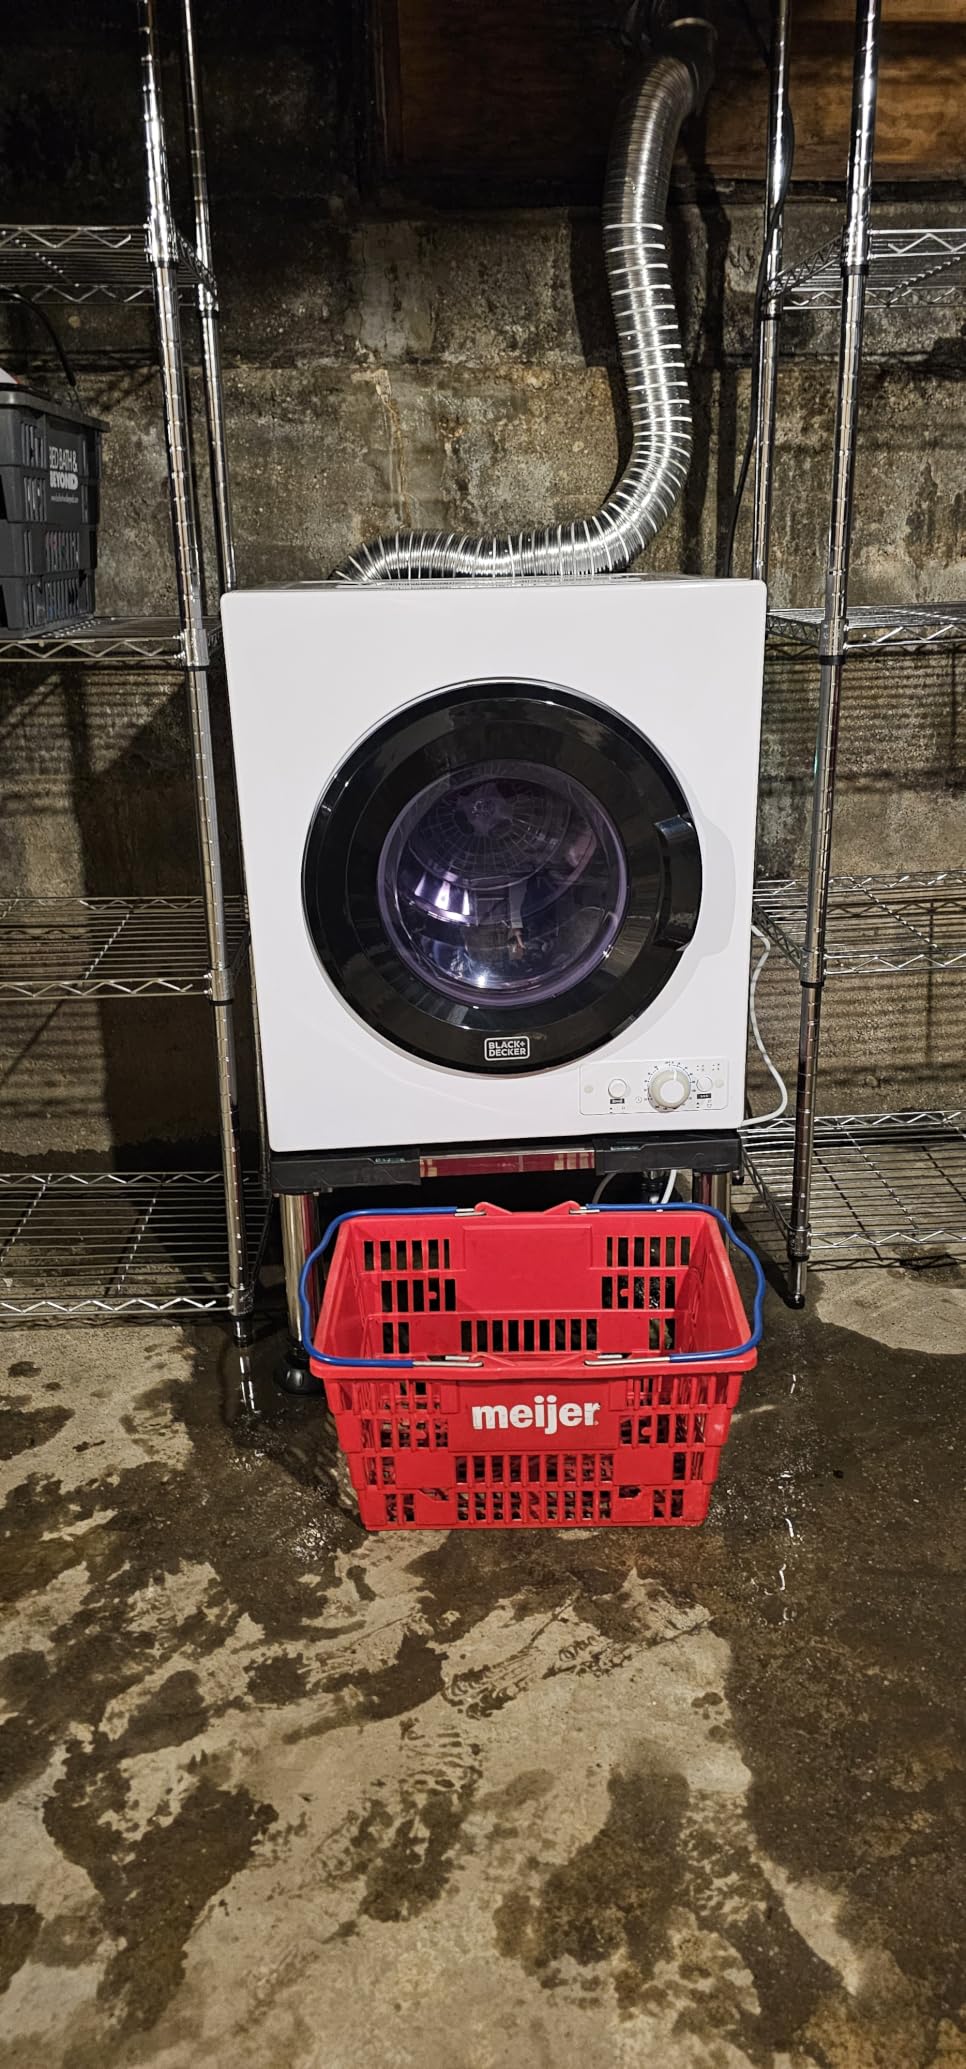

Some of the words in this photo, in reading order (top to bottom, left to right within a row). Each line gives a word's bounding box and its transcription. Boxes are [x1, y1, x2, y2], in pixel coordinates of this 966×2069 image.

[50, 470, 79, 491] BEYOND
[488, 1047, 527, 1057] DECKER
[471, 1394, 600, 1435] meijer
